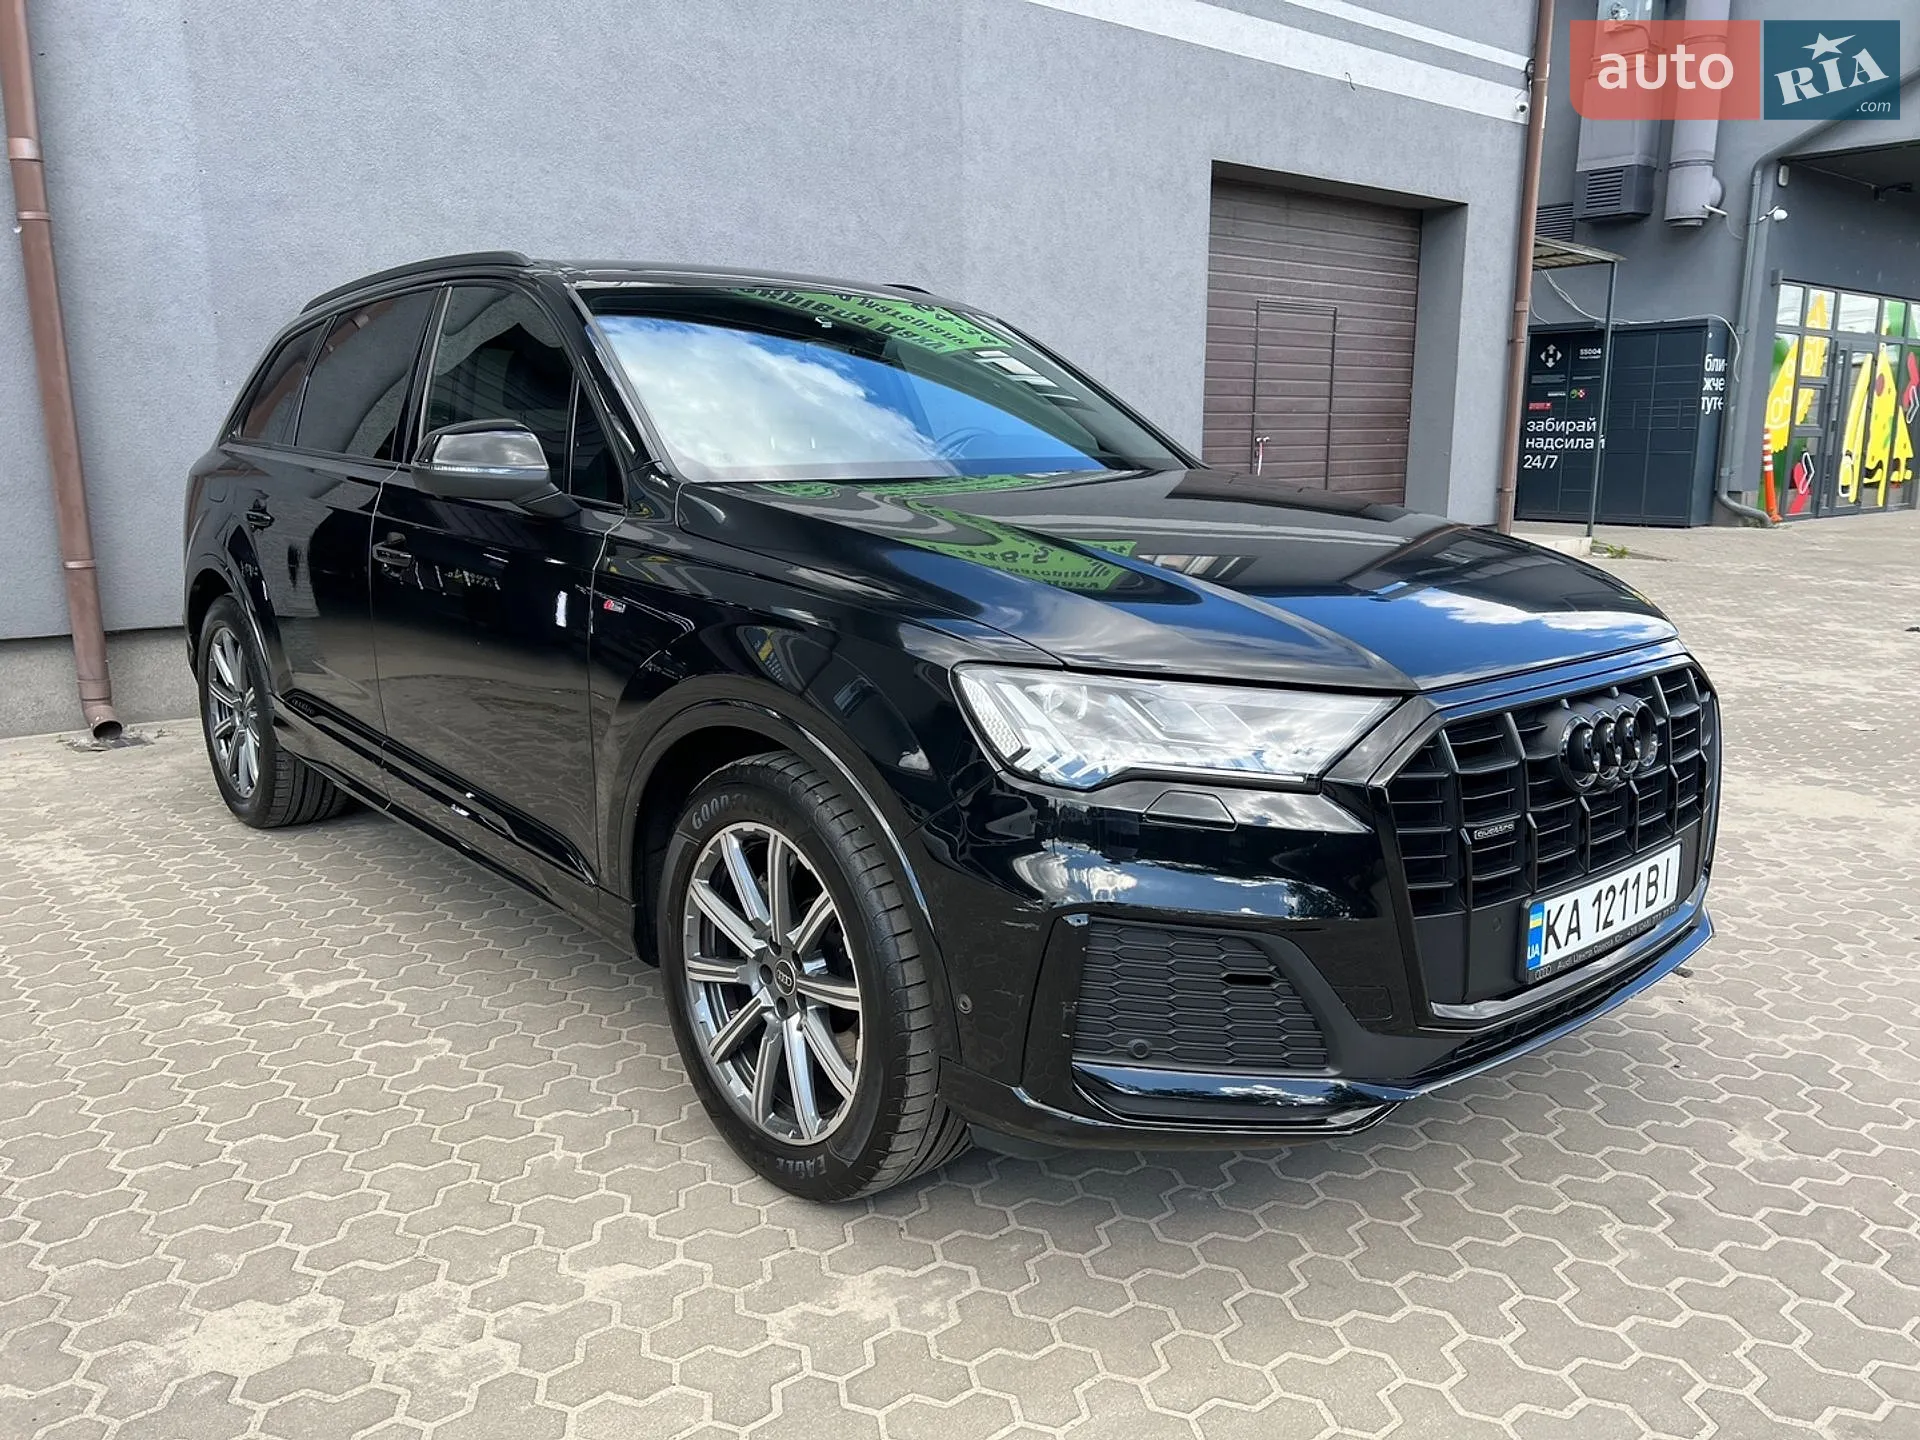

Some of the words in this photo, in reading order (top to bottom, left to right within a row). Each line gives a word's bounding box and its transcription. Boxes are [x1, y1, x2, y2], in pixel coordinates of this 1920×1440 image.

[1702, 377, 1725, 391] жче
[1526, 417, 1597, 435] забирай
[1523, 454, 1558, 469] 24/7
[1543, 898, 1582, 956] KA
[1592, 871, 1641, 933] 1211
[1645, 857, 1670, 909] BI
[1527, 943, 1540, 960] UA
